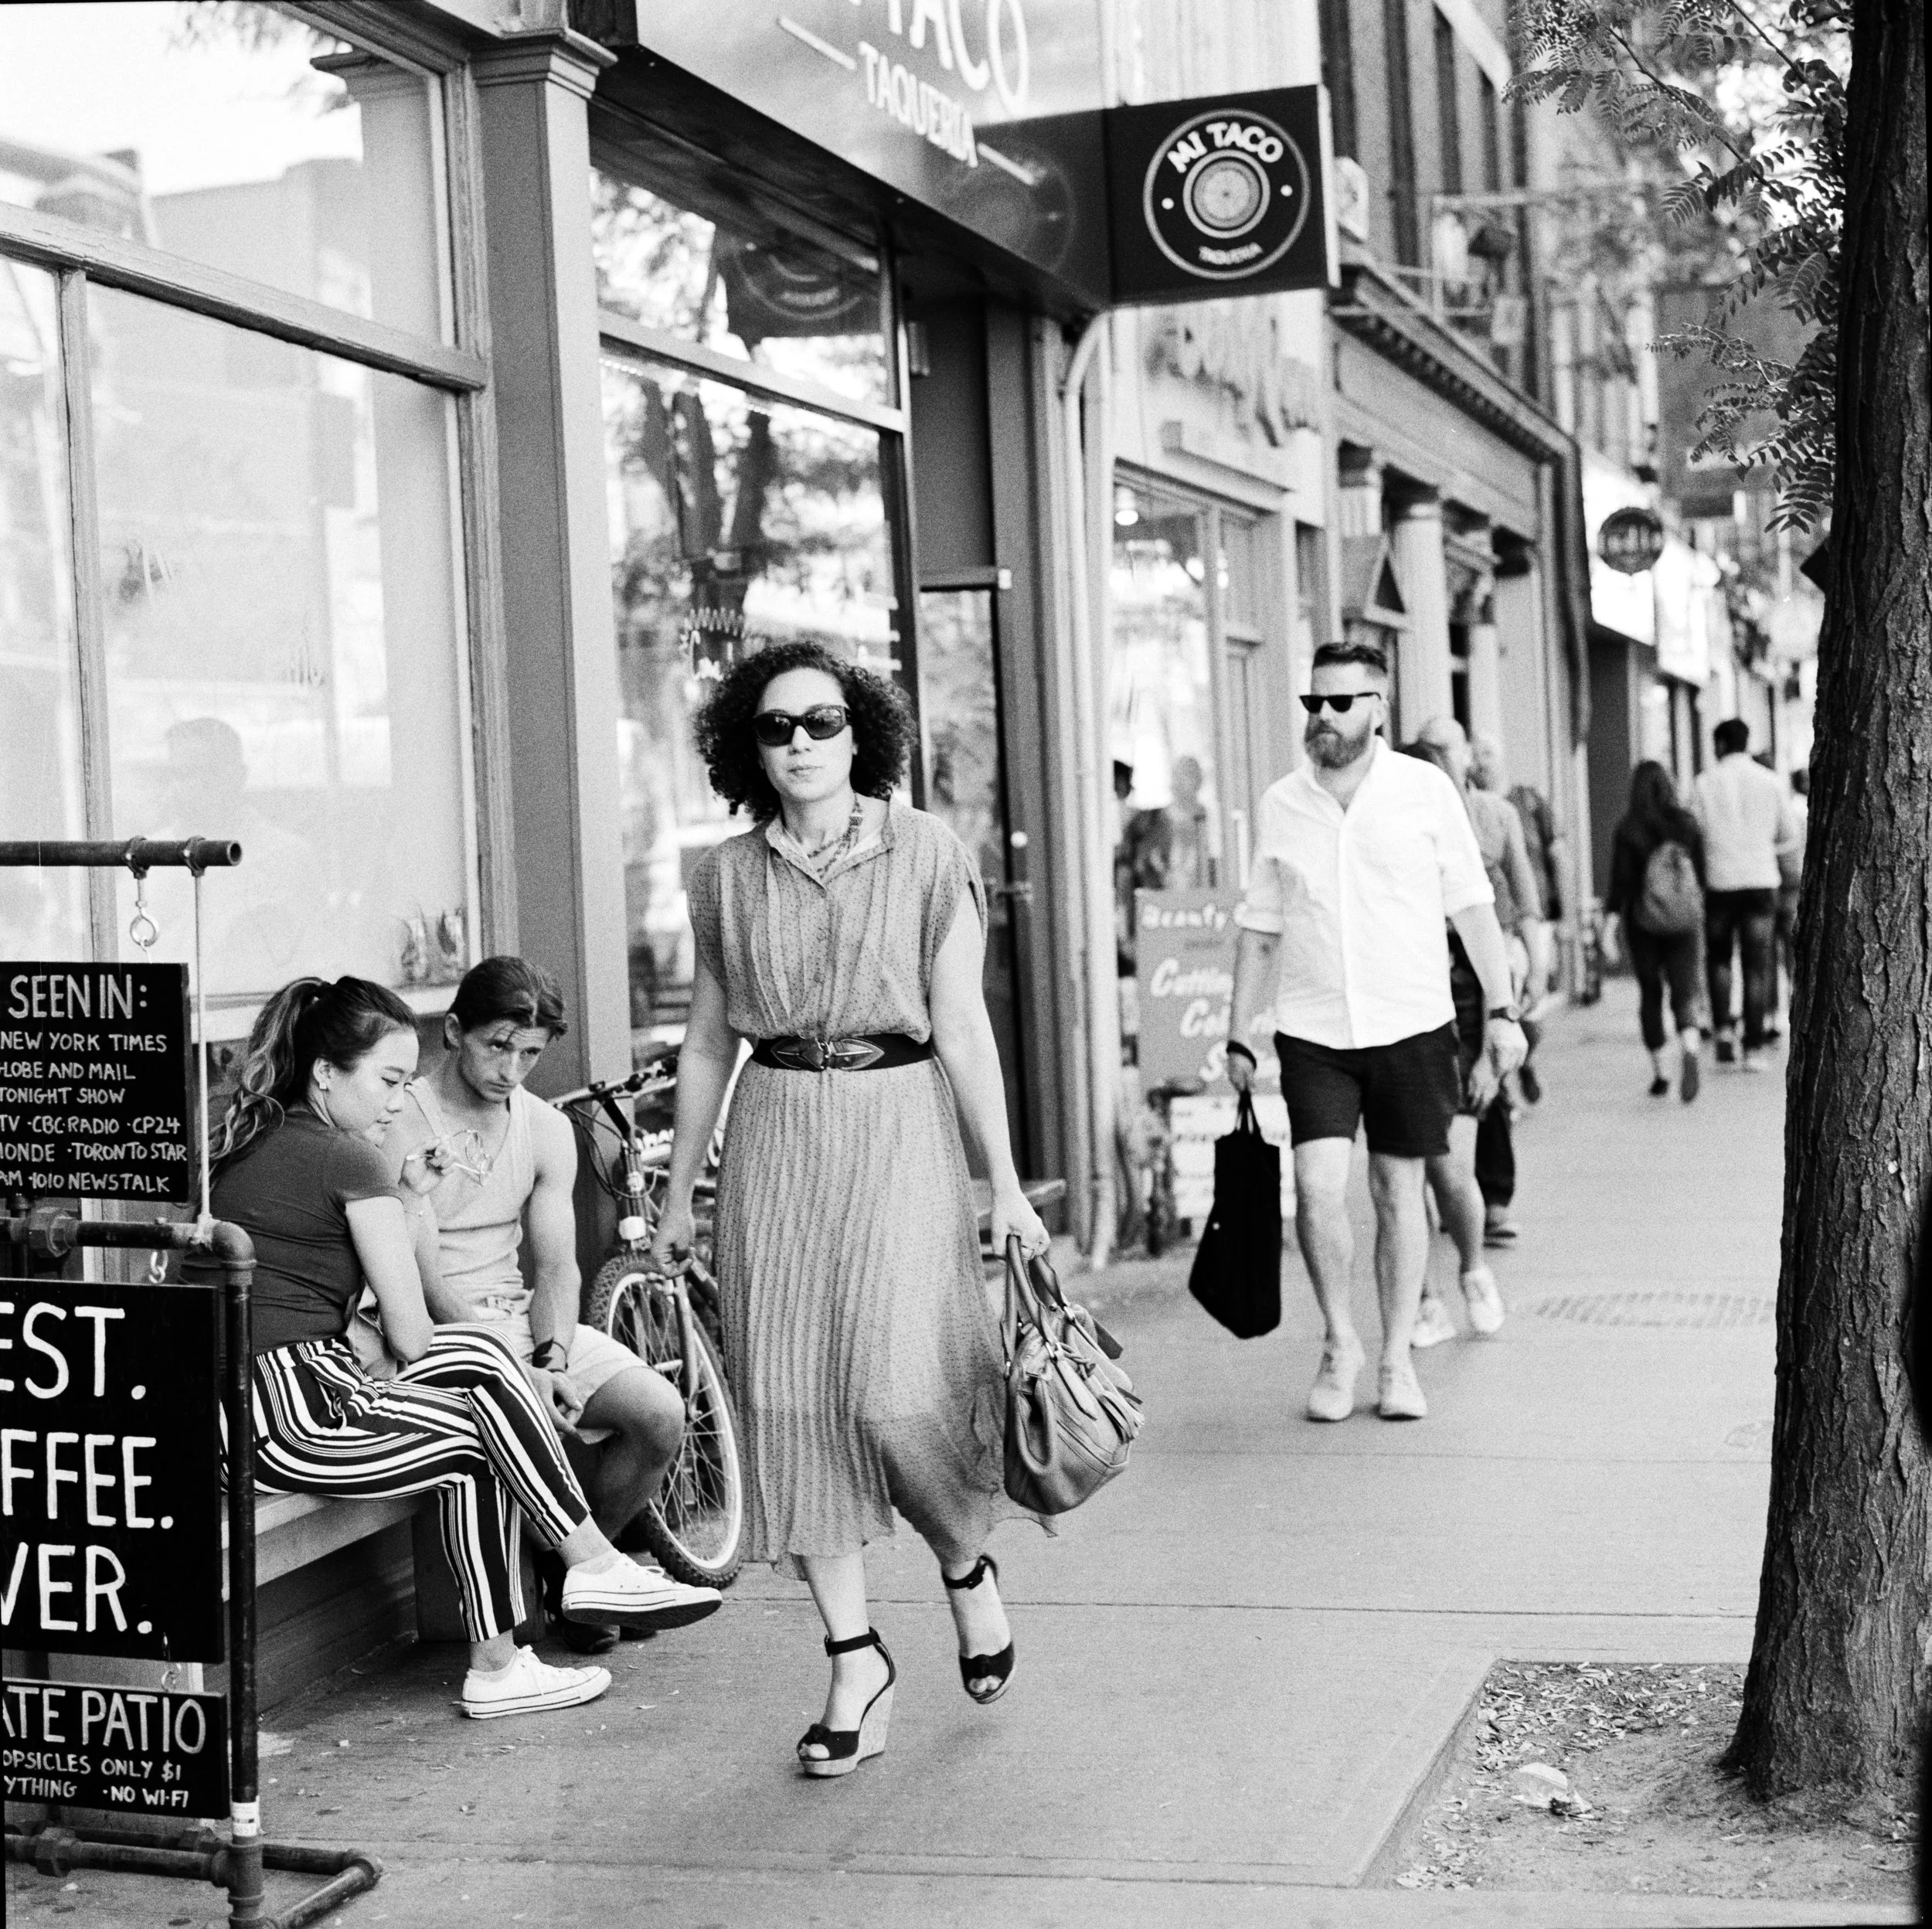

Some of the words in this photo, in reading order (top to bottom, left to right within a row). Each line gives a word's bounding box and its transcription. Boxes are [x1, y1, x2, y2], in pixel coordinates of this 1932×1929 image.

[1167, 130, 1208, 174] MI
[1206, 121, 1284, 164] TACO
[8, 974, 90, 1019] SEEN
[100, 974, 147, 1019] IN:
[0, 1030, 43, 1050] NEW
[49, 1032, 100, 1052] YORK
[108, 1033, 167, 1053] TIMES
[0, 1061, 43, 1079] LOBE
[48, 1062, 84, 1079] AND
[89, 1063, 136, 1080] MAIL
[0, 1087, 73, 1104] TONIGHT
[77, 1087, 125, 1104] SHOW
[0, 1114, 20, 1132] TV
[0, 1142, 55, 1162] ONDE
[71, 1141, 148, 1162] TORONTO
[151, 1141, 187, 1162] STAR
[1, 1428, 174, 1529] FFEE.
[81, 1689, 206, 1754] PATIO
[3, 1749, 91, 1774] OPSICLES
[100, 1758, 153, 1778] ONLY
[162, 1760, 181, 1782] $1
[4, 1775, 77, 1798] YTHING
